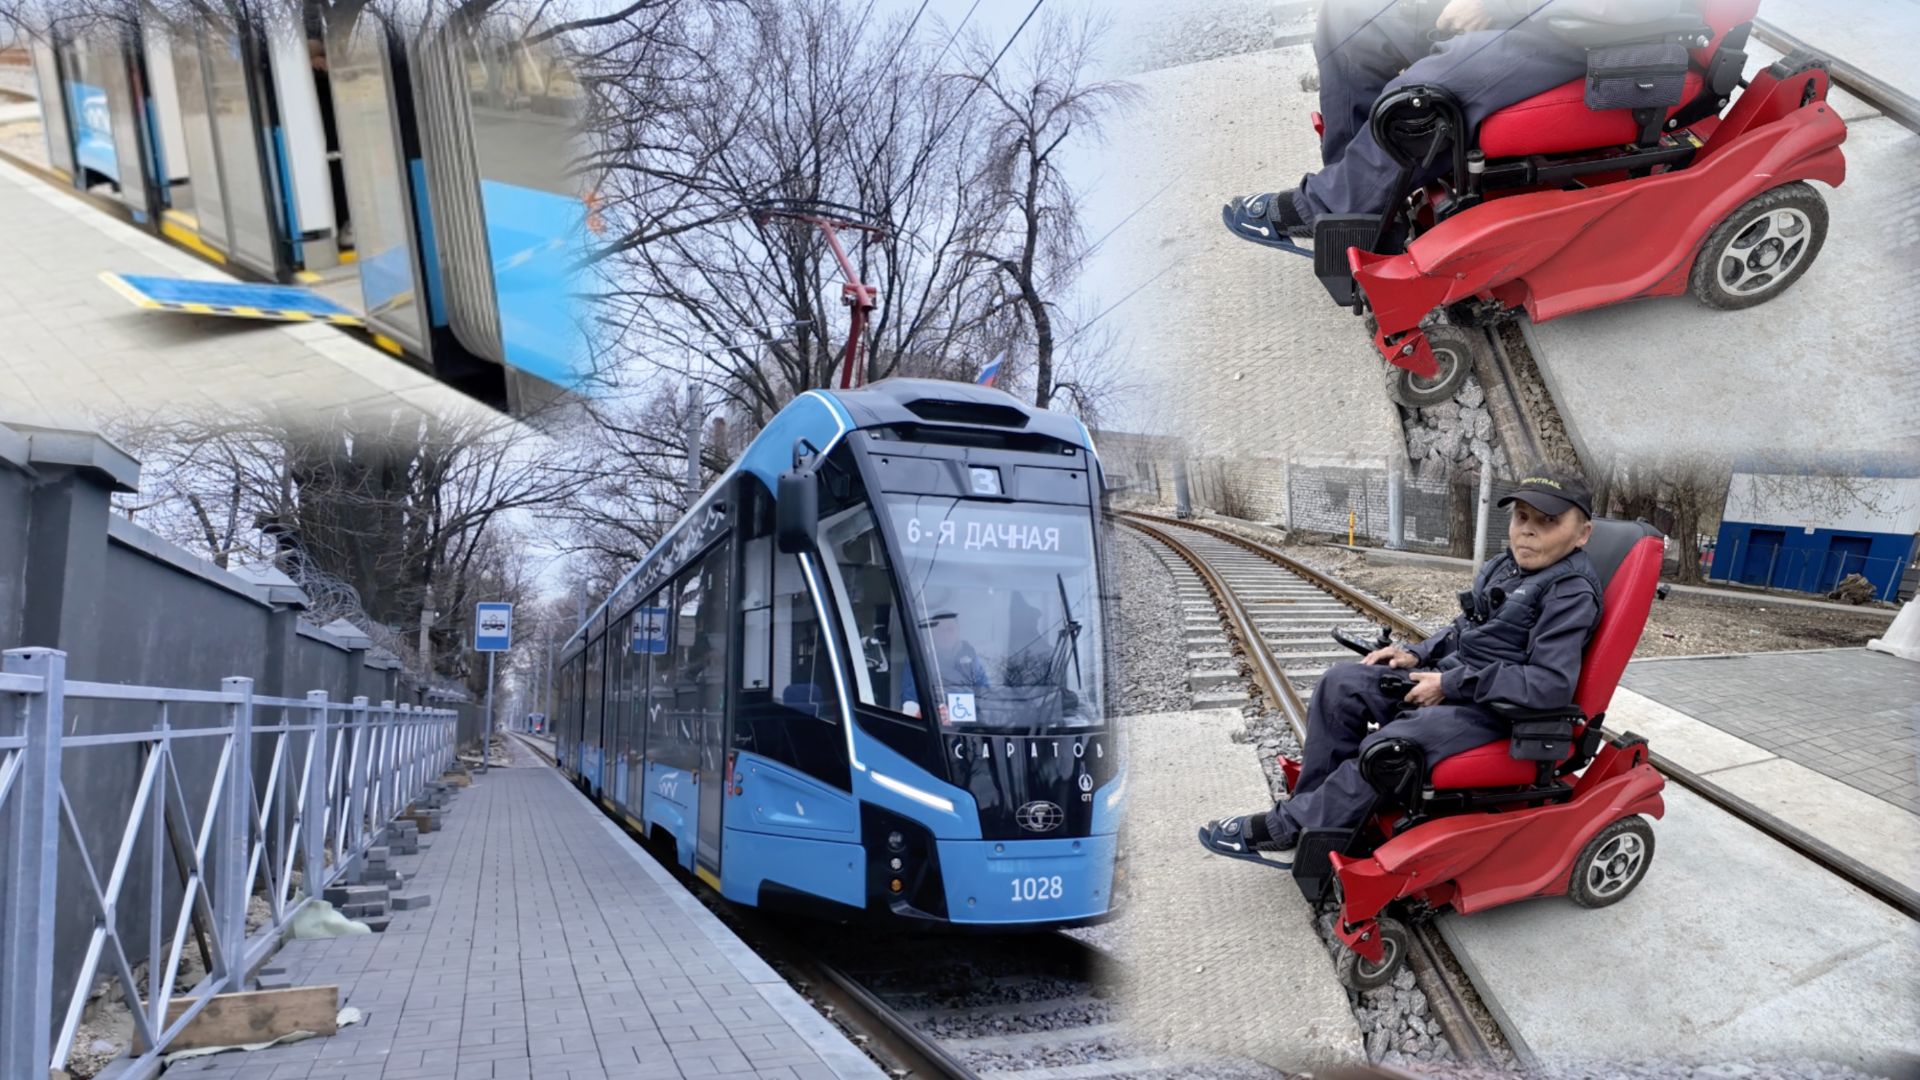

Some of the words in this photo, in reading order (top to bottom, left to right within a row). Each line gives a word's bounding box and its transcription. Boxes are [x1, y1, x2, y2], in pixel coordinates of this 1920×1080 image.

[971, 467, 997, 495] 3
[964, 521, 1060, 552] ДАЧНАЯ
[1011, 875, 1063, 902] 1028
